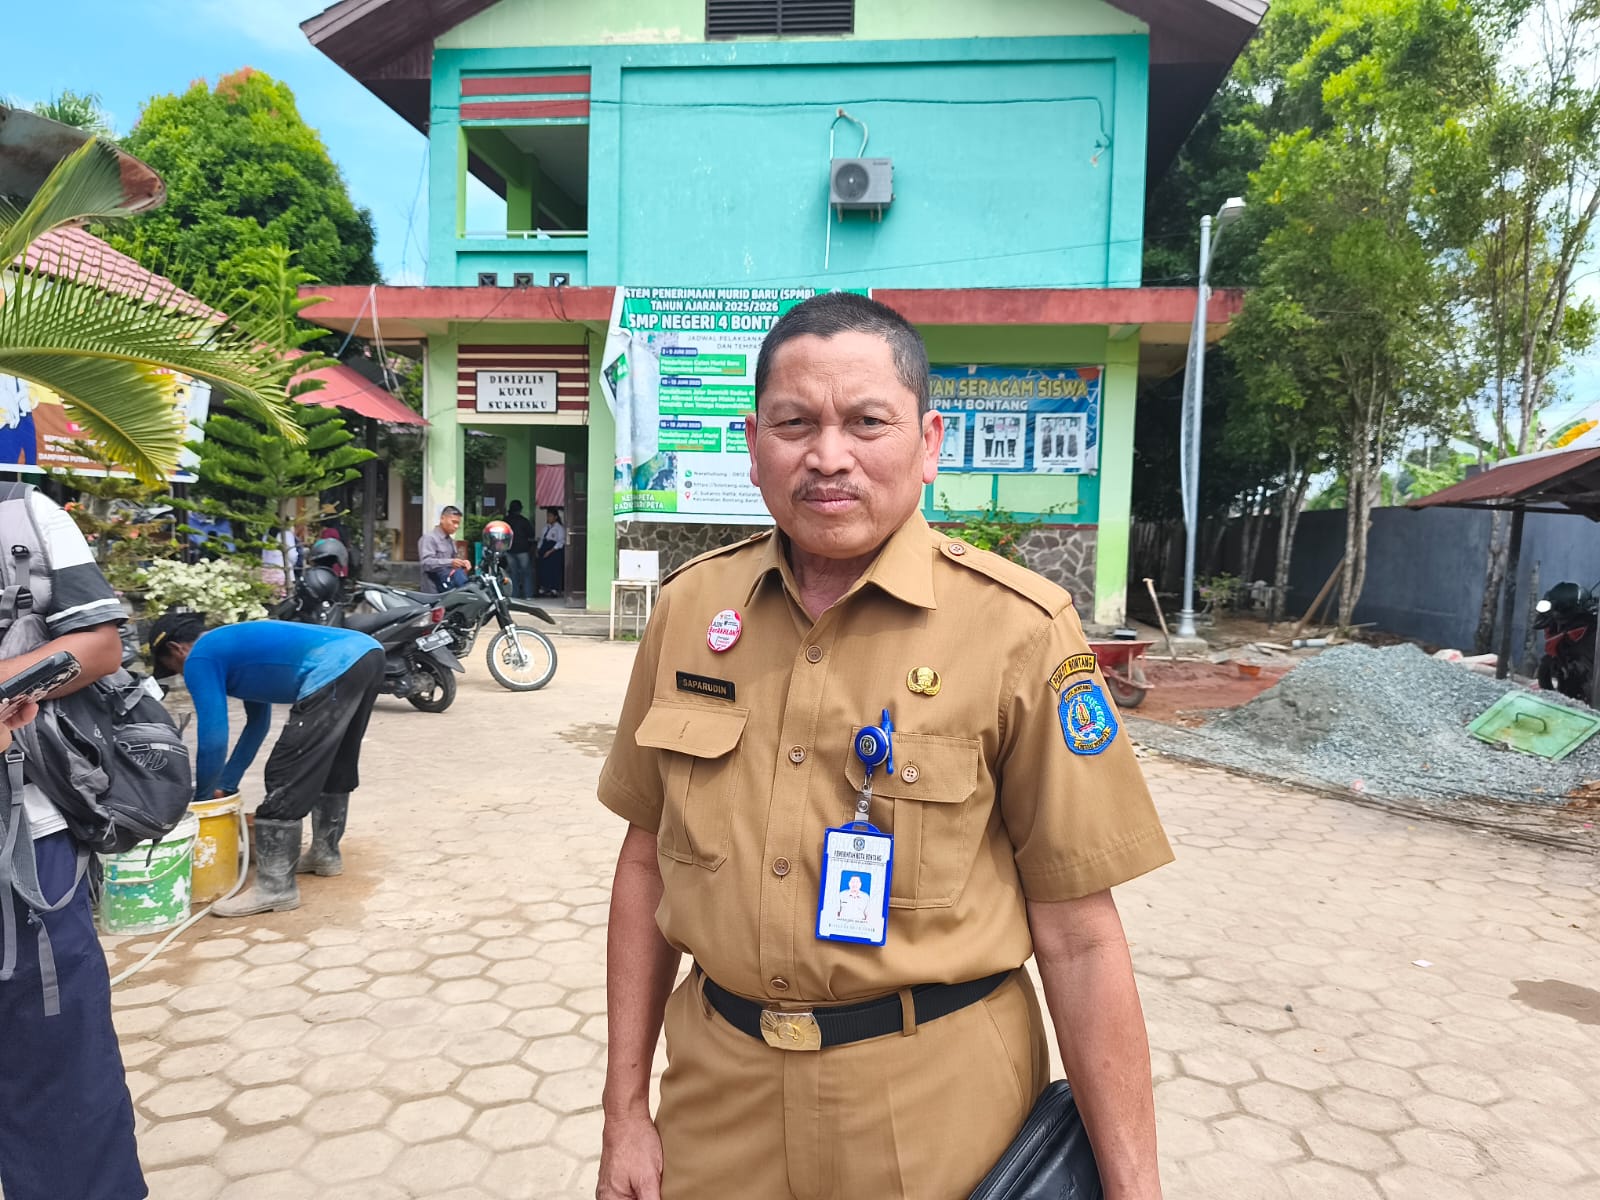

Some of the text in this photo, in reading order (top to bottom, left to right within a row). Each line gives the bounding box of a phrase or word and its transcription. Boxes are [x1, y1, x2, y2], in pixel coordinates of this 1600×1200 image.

[651, 287, 716, 299] PENERIMAAN
[717, 288, 750, 300] MURID
[751, 288, 778, 300] BARU
[650, 300, 779, 313] TAHUN AJARAN 2025/2026
[628, 313, 659, 329] SMP
[661, 314, 715, 330] NEGERI
[718, 315, 729, 330] 4
[489, 375, 545, 384] DISIPLIN
[498, 387, 533, 396] KUNCI
[959, 379, 1034, 398] SERAGAM
[1037, 379, 1089, 398] SISWA
[488, 400, 548, 409] SUKSESKU
[953, 400, 962, 410] 4
[966, 400, 1028, 410] BONTANG
[682, 678, 727, 695] SAPARUDIN
